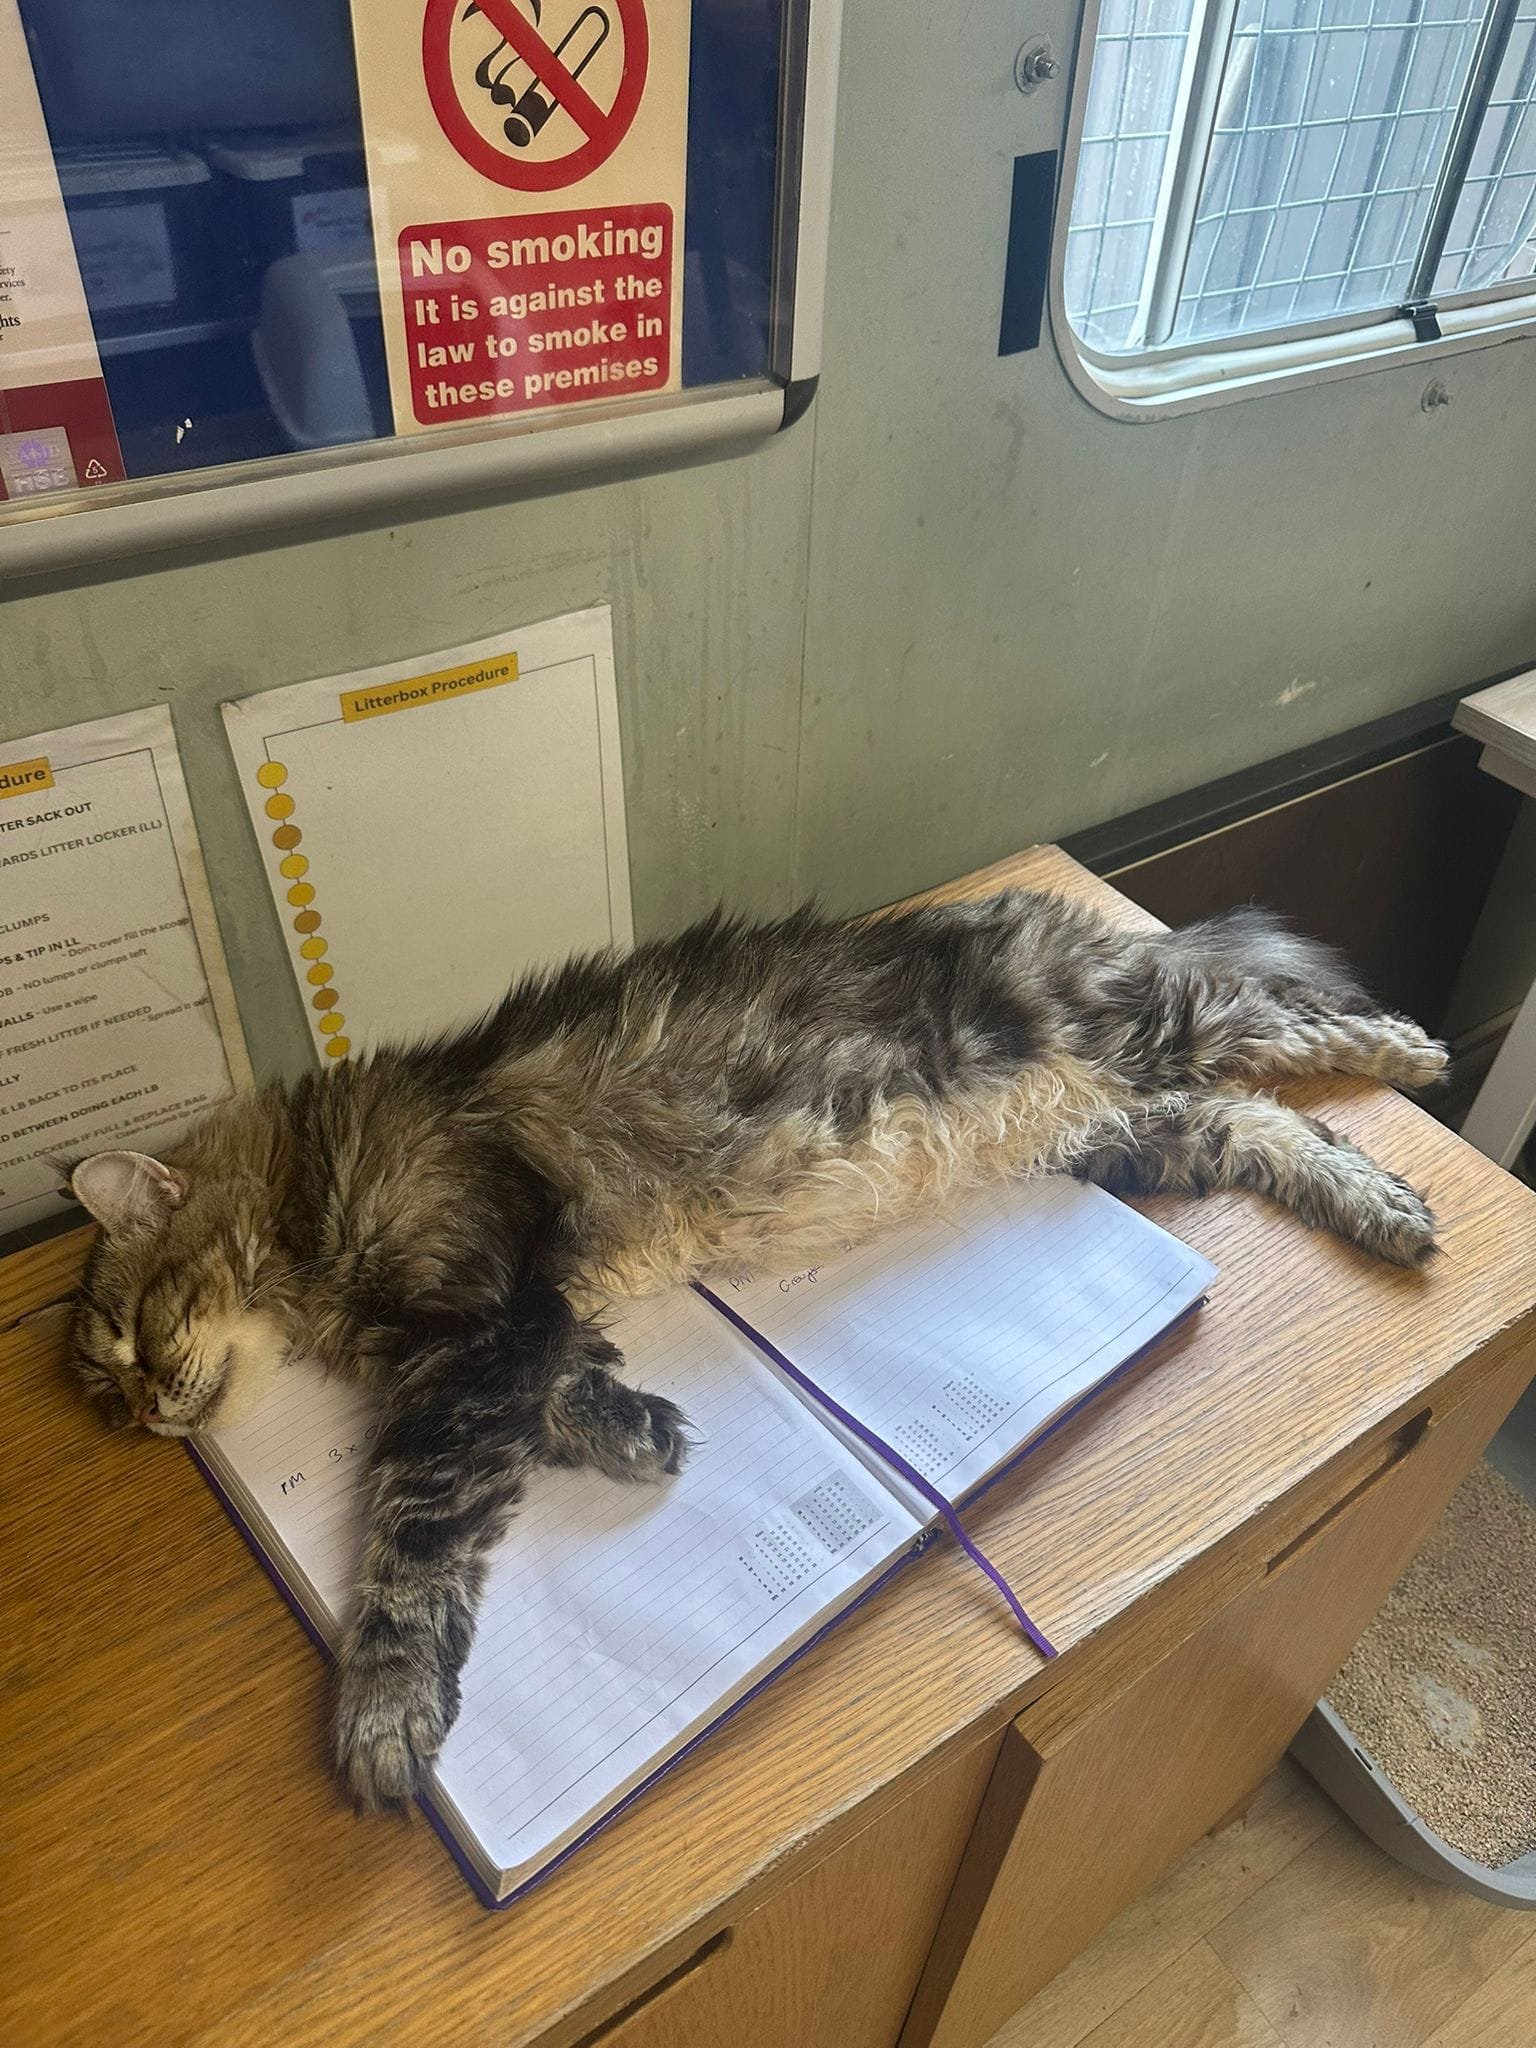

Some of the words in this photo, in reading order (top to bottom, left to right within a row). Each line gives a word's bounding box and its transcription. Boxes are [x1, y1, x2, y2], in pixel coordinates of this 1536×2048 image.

[410, 238, 472, 277] No
[487, 221, 663, 268] smoking
[415, 299, 440, 326] It
[450, 295, 478, 321] is
[489, 280, 604, 320] against
[615, 274, 663, 300] the
[417, 342, 474, 368] law
[486, 335, 517, 359] to
[528, 320, 627, 352] smoke
[637, 313, 662, 338] in
[425, 378, 514, 408] these
[525, 357, 658, 399] premises
[355, 686, 428, 712] Litterbox
[432, 665, 510, 694] Procedure
[0, 770, 46, 789] dure
[26, 810, 63, 825] SACK
[65, 802, 92, 816] OUT
[0, 850, 38, 868] ARDS
[40, 839, 84, 856] LITTER
[86, 826, 138, 845] LOCKER
[139, 819, 163, 832] (LL)
[0, 913, 50, 934] CLUMPS
[68, 943, 98, 957] Don't
[99, 936, 122, 948] over
[15, 953, 24, 961] &
[25, 946, 46, 958] TIP
[48, 941, 62, 952] IN
[64, 937, 81, 948] LL
[23, 980, 41, 990] NO
[77, 966, 88, 975] or
[90, 955, 128, 970] clumps
[6, 1038, 47, 1056] FRESH
[48, 1024, 89, 1043] LITTER
[90, 1020, 101, 1030] IF
[103, 1005, 152, 1026] NEEDED
[42, 1004, 63, 1015] Use
[11, 1101, 26, 1112] LB
[28, 1089, 61, 1106] BACK
[62, 1084, 80, 1094] TO
[81, 1078, 100, 1088] ITS
[101, 1064, 138, 1081] PLACE
[12, 1114, 69, 1139] BETWEEN
[70, 1100, 109, 1119] DOING
[111, 1089, 142, 1105] EACH
[144, 1083, 159, 1094] LB
